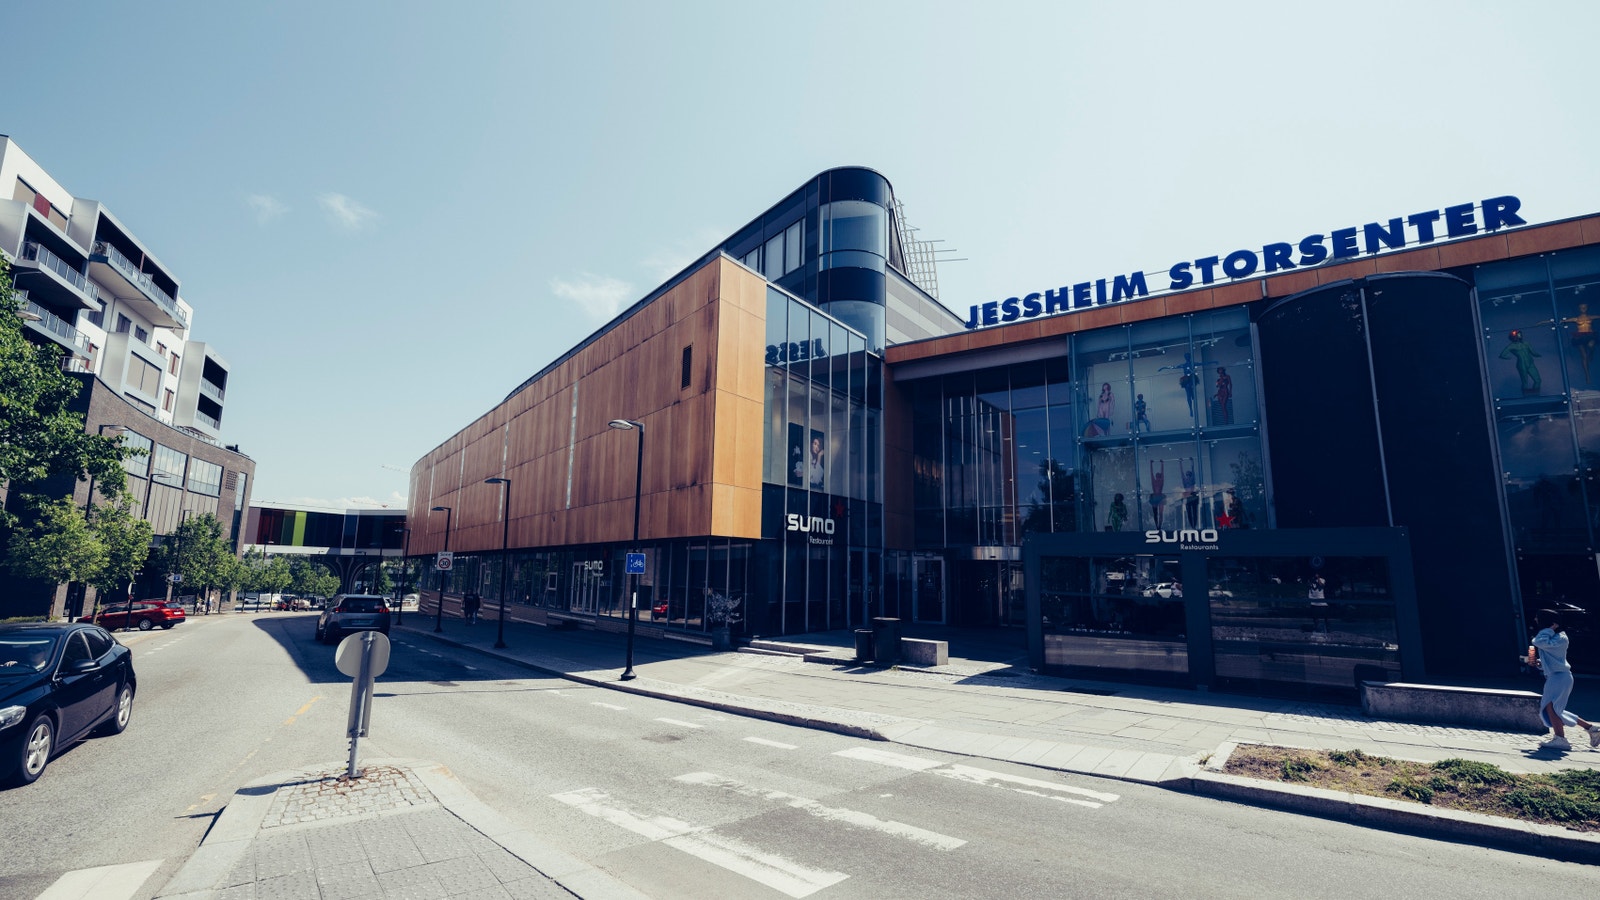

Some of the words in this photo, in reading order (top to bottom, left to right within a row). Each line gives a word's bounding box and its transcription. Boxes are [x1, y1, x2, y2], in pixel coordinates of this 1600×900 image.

[965, 271, 1149, 329] JESSHEIM
[1169, 195, 1527, 290] STORSENTER
[787, 513, 835, 535] SUMO
[1145, 529, 1218, 543] SUMO
[584, 560, 603, 570] SUMO
